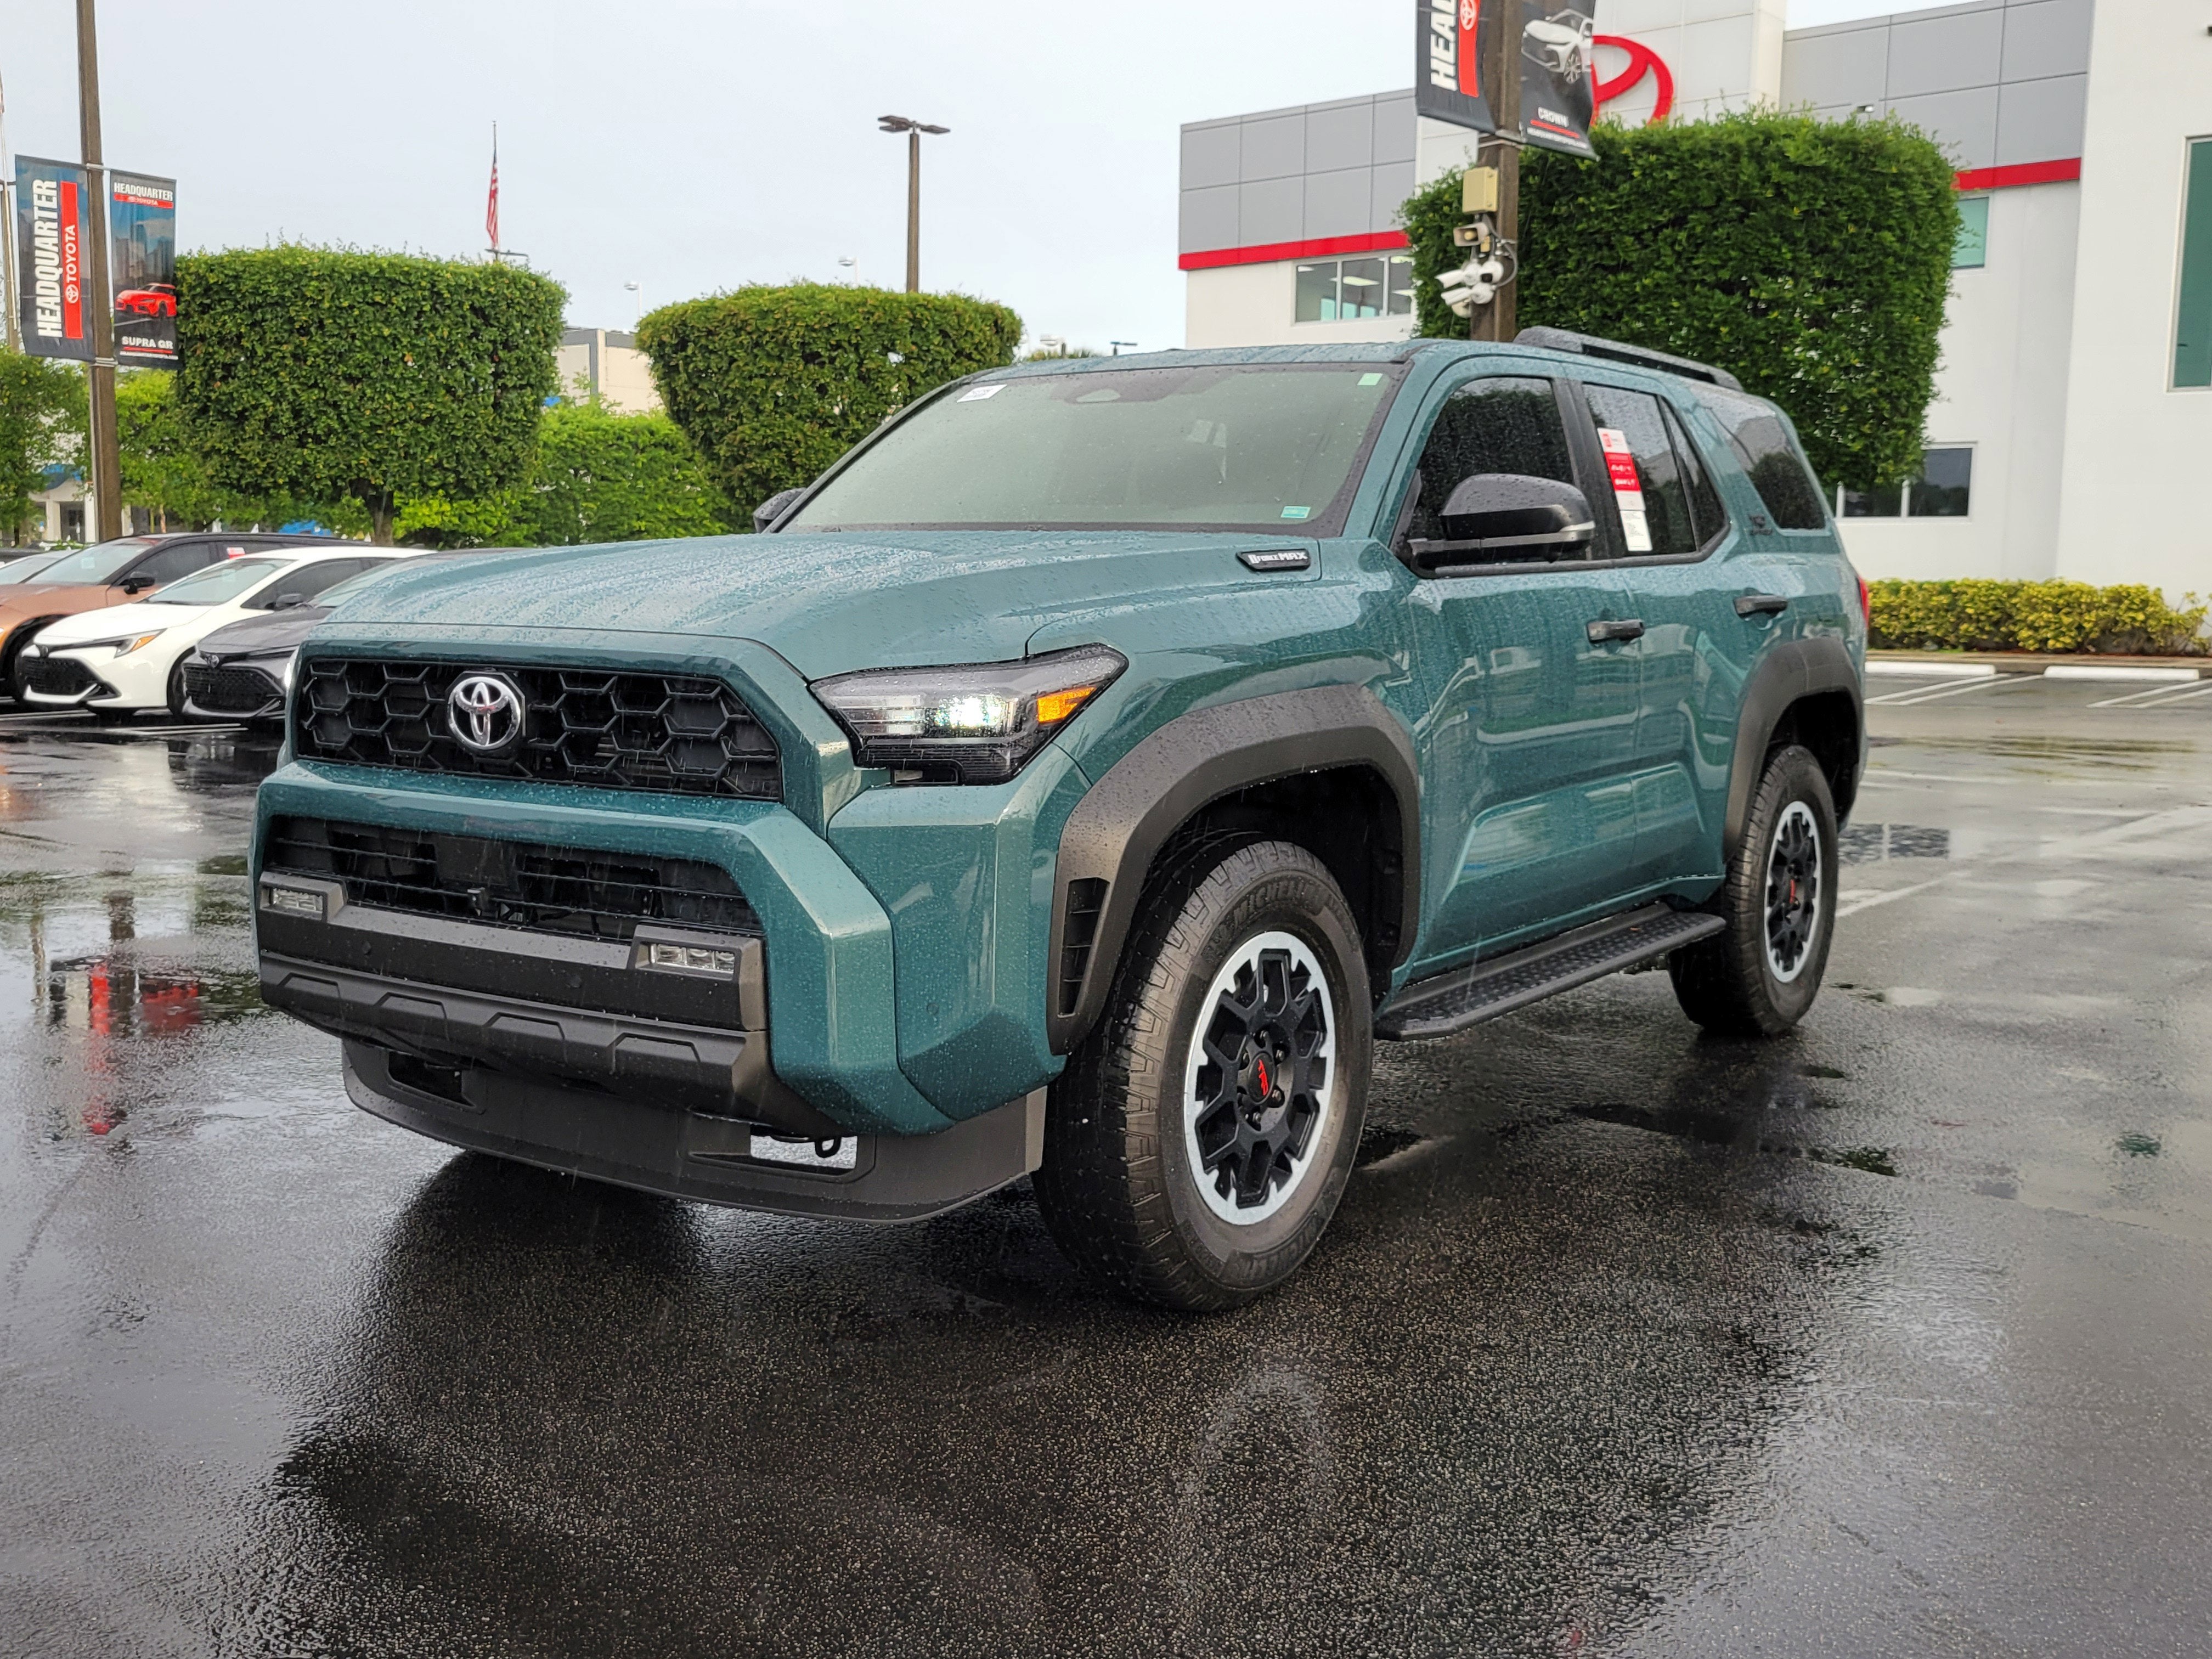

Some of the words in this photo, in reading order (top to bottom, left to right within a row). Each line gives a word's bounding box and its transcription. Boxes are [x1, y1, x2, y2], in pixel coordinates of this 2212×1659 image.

[114, 182, 173, 201] HEADQUARTER
[32, 179, 63, 337] HEADQUARTER
[65, 224, 77, 283] TOYOTA
[122, 336, 156, 348] SUPRA
[157, 340, 173, 349] GR
[1278, 552, 1308, 561] MAX
